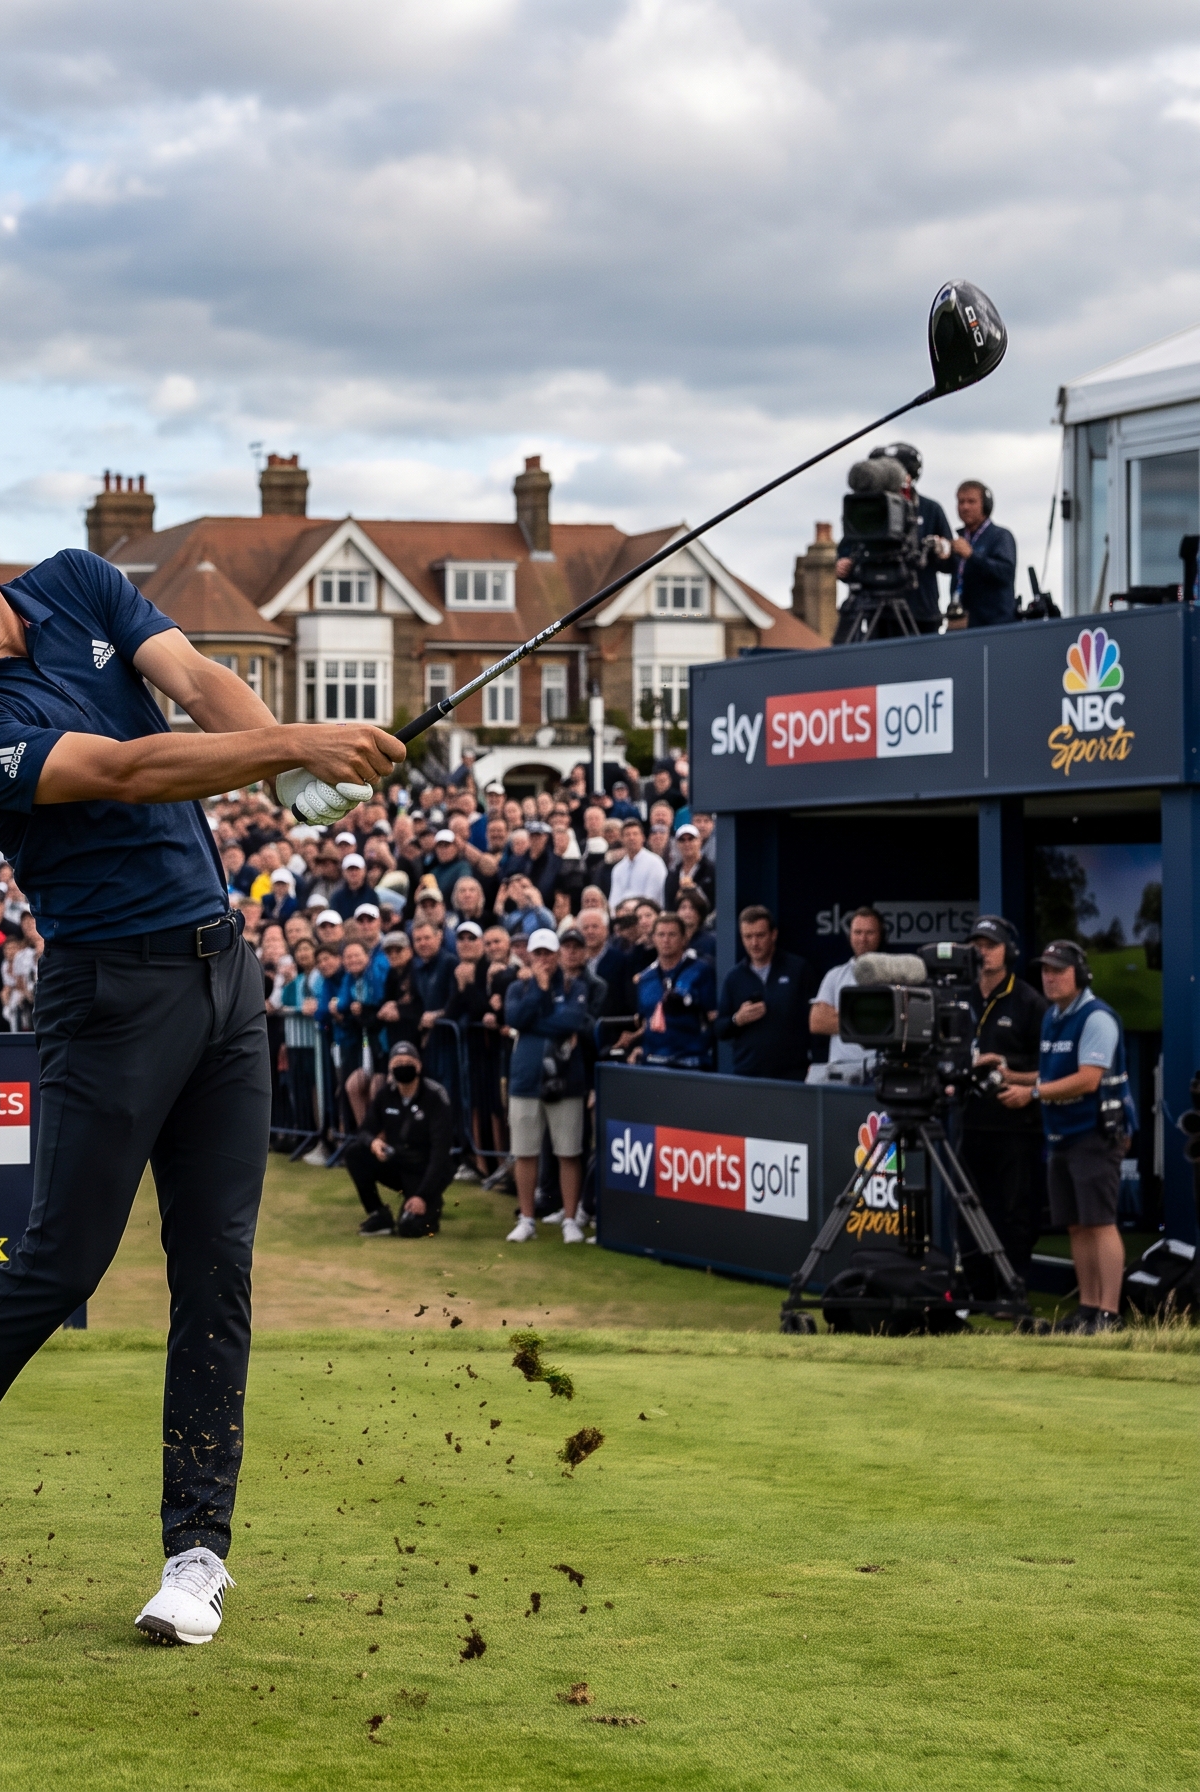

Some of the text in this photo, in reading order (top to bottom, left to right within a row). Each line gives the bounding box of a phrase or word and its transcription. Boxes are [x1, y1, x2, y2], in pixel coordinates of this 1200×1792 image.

[711, 690, 944, 764] sky sports golf
[1062, 693, 1126, 732] NBC
[1047, 724, 1135, 776] Sports
[816, 903, 853, 935] sk
[610, 1128, 801, 1202] sky sports golf
